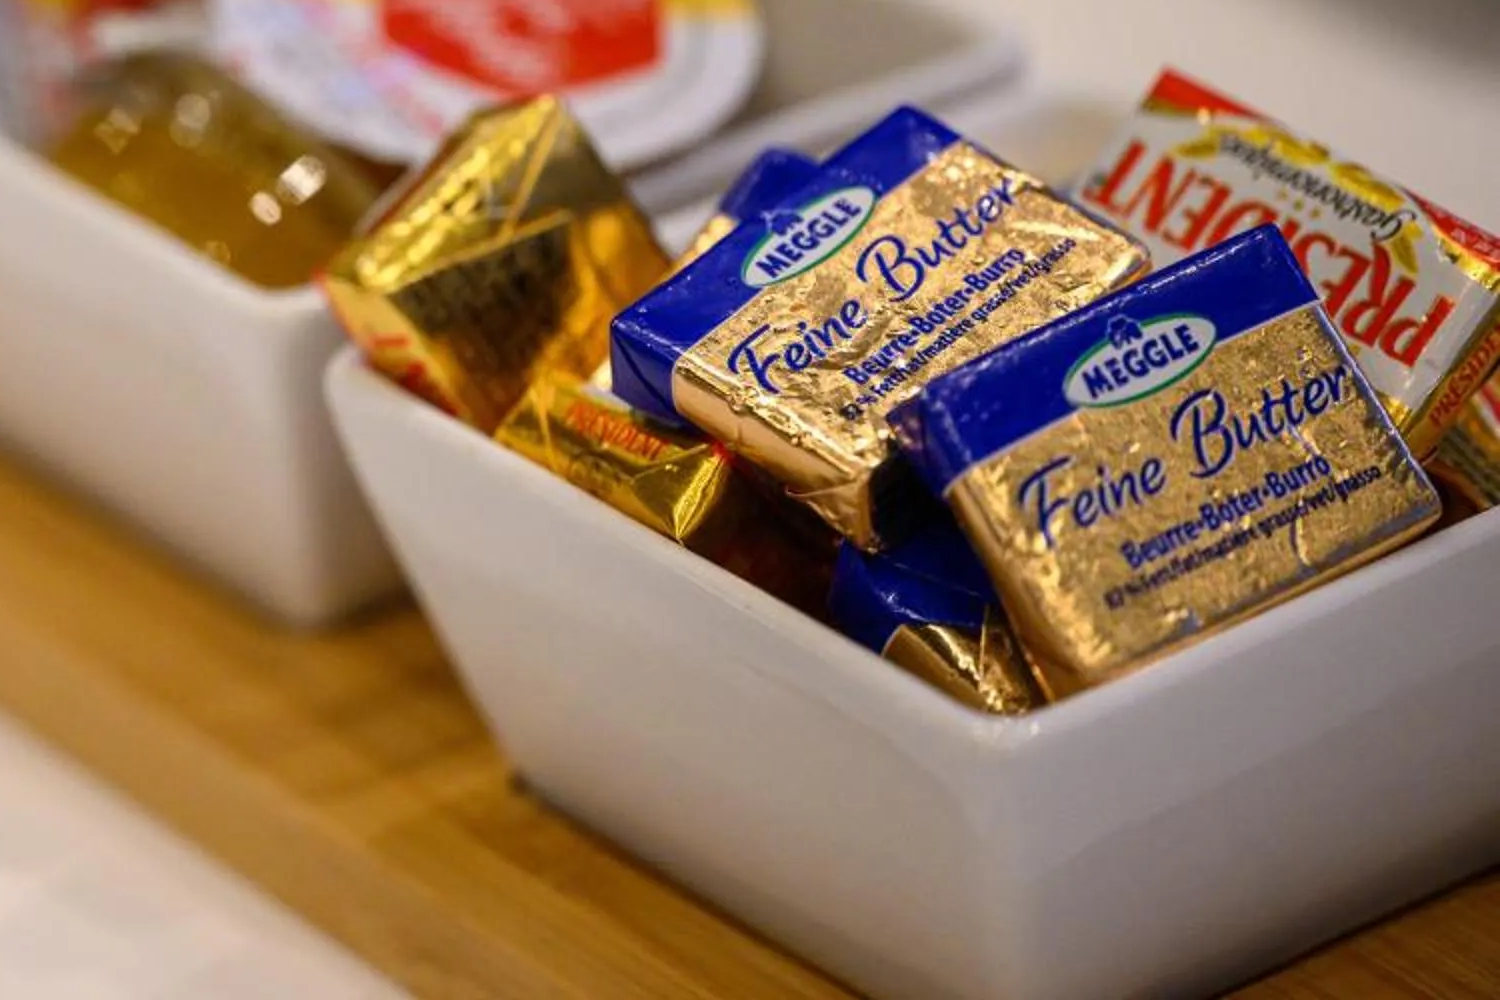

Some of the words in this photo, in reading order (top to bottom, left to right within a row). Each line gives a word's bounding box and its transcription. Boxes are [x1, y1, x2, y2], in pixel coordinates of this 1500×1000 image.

[727, 293, 869, 395] Feine
[855, 175, 1020, 302] Butter
[757, 198, 861, 279] MEGGLE
[1082, 139, 1454, 368] PRESDENT
[1081, 323, 1199, 399] MEGGLE
[1017, 455, 1168, 549] Feine
[1169, 367, 1348, 480] Butter
